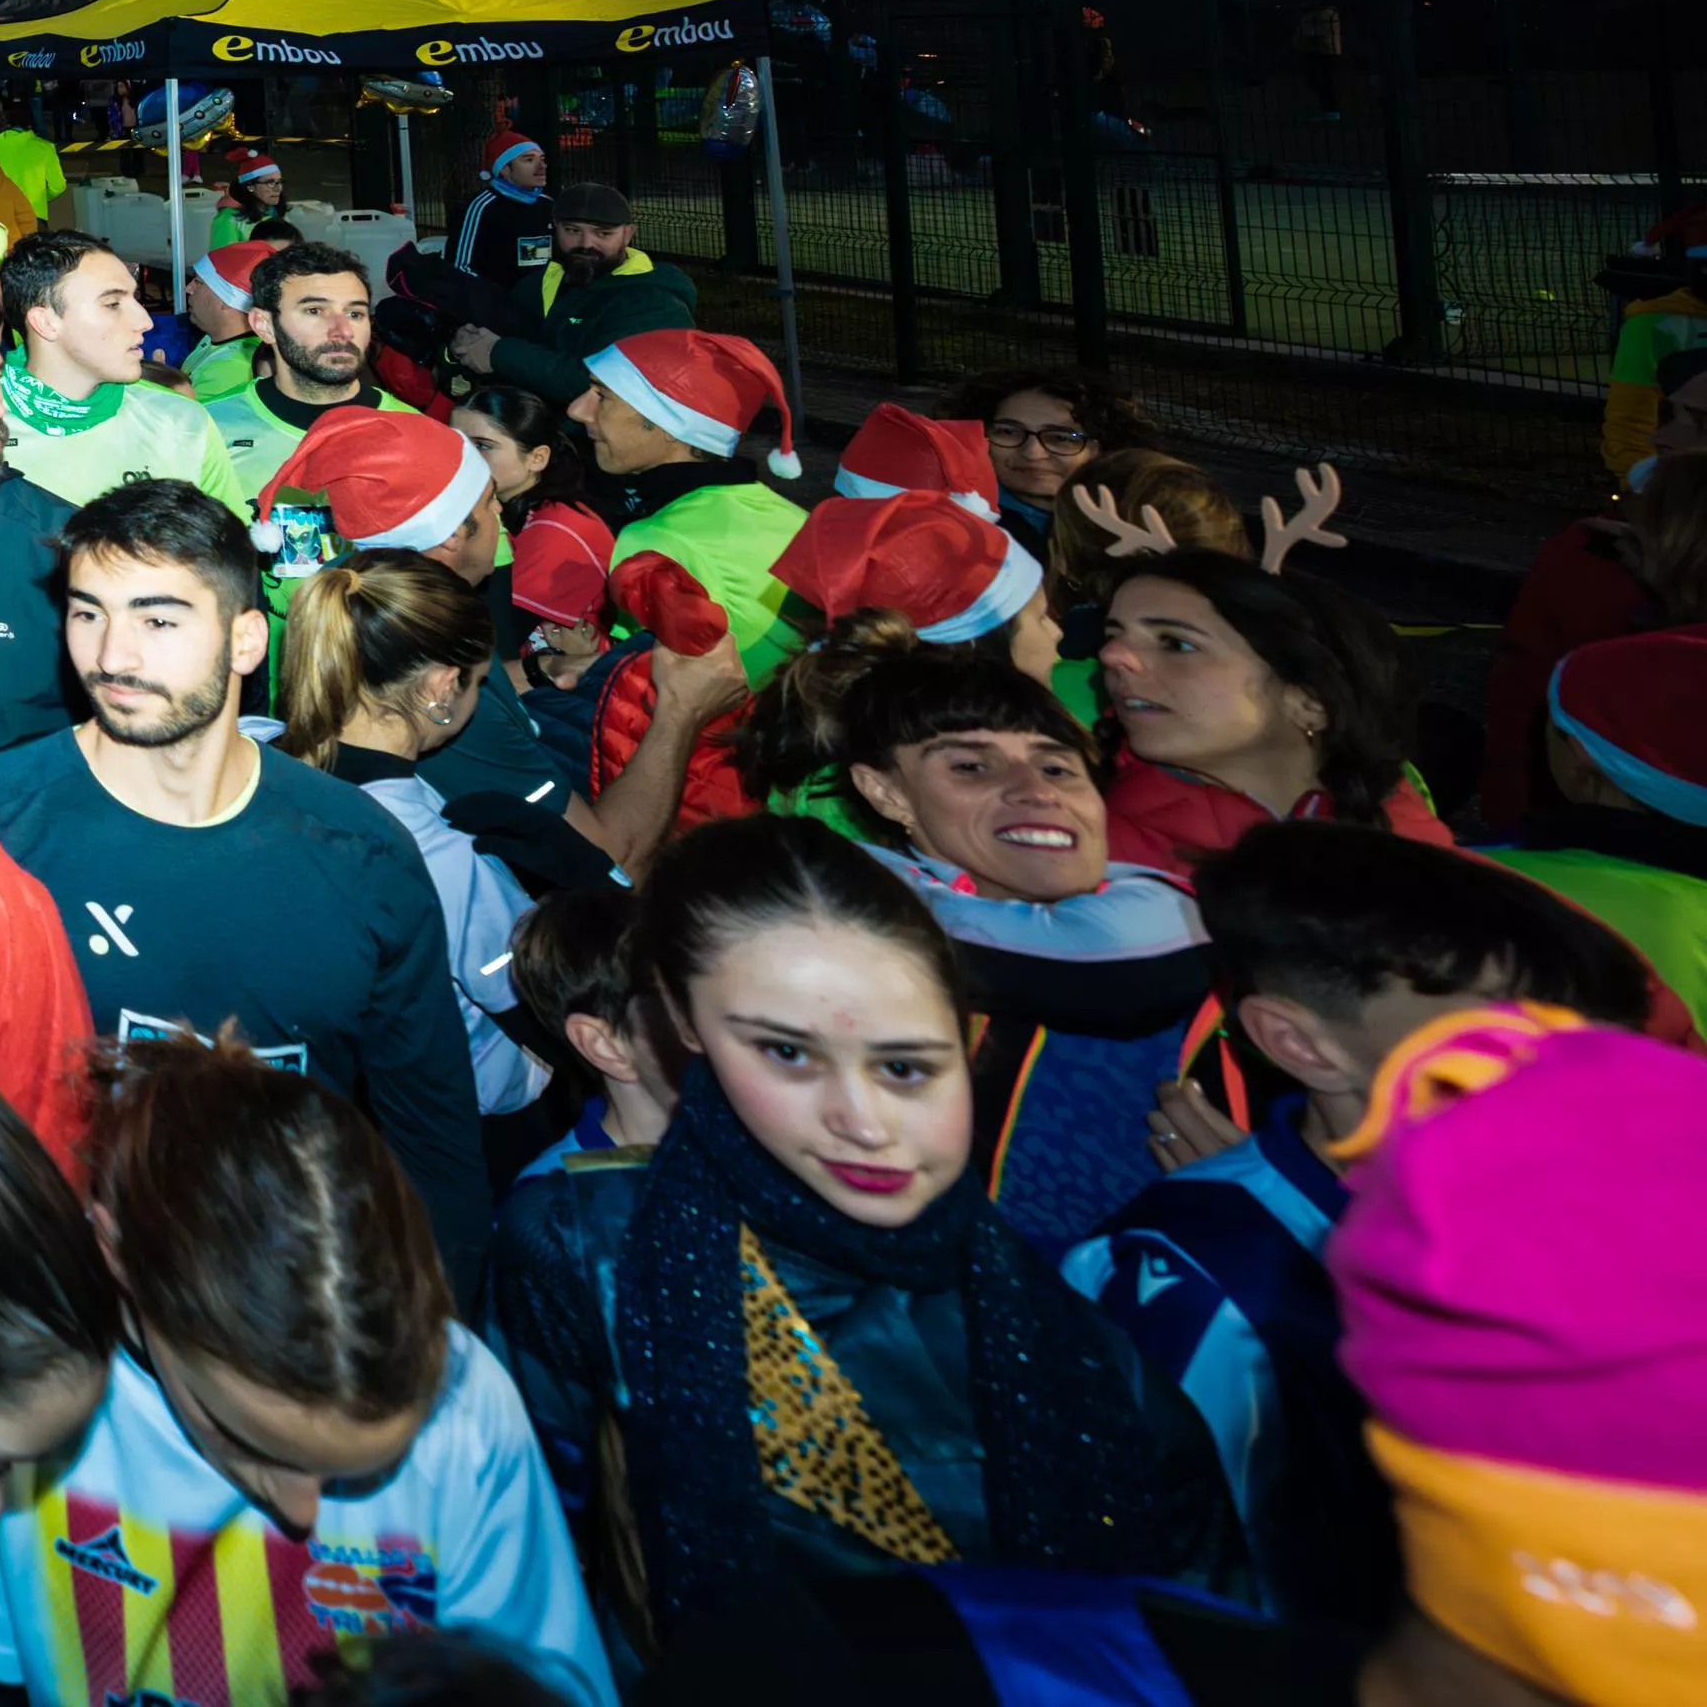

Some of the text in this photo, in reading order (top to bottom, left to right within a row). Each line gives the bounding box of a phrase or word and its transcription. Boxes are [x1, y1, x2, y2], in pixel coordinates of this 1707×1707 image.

[615, 16, 734, 53] embou
[7, 48, 57, 69] embou
[80, 39, 145, 67] embou
[212, 35, 342, 65] embou
[415, 36, 544, 66] embou
[55, 1536, 161, 1597] MERCURY
